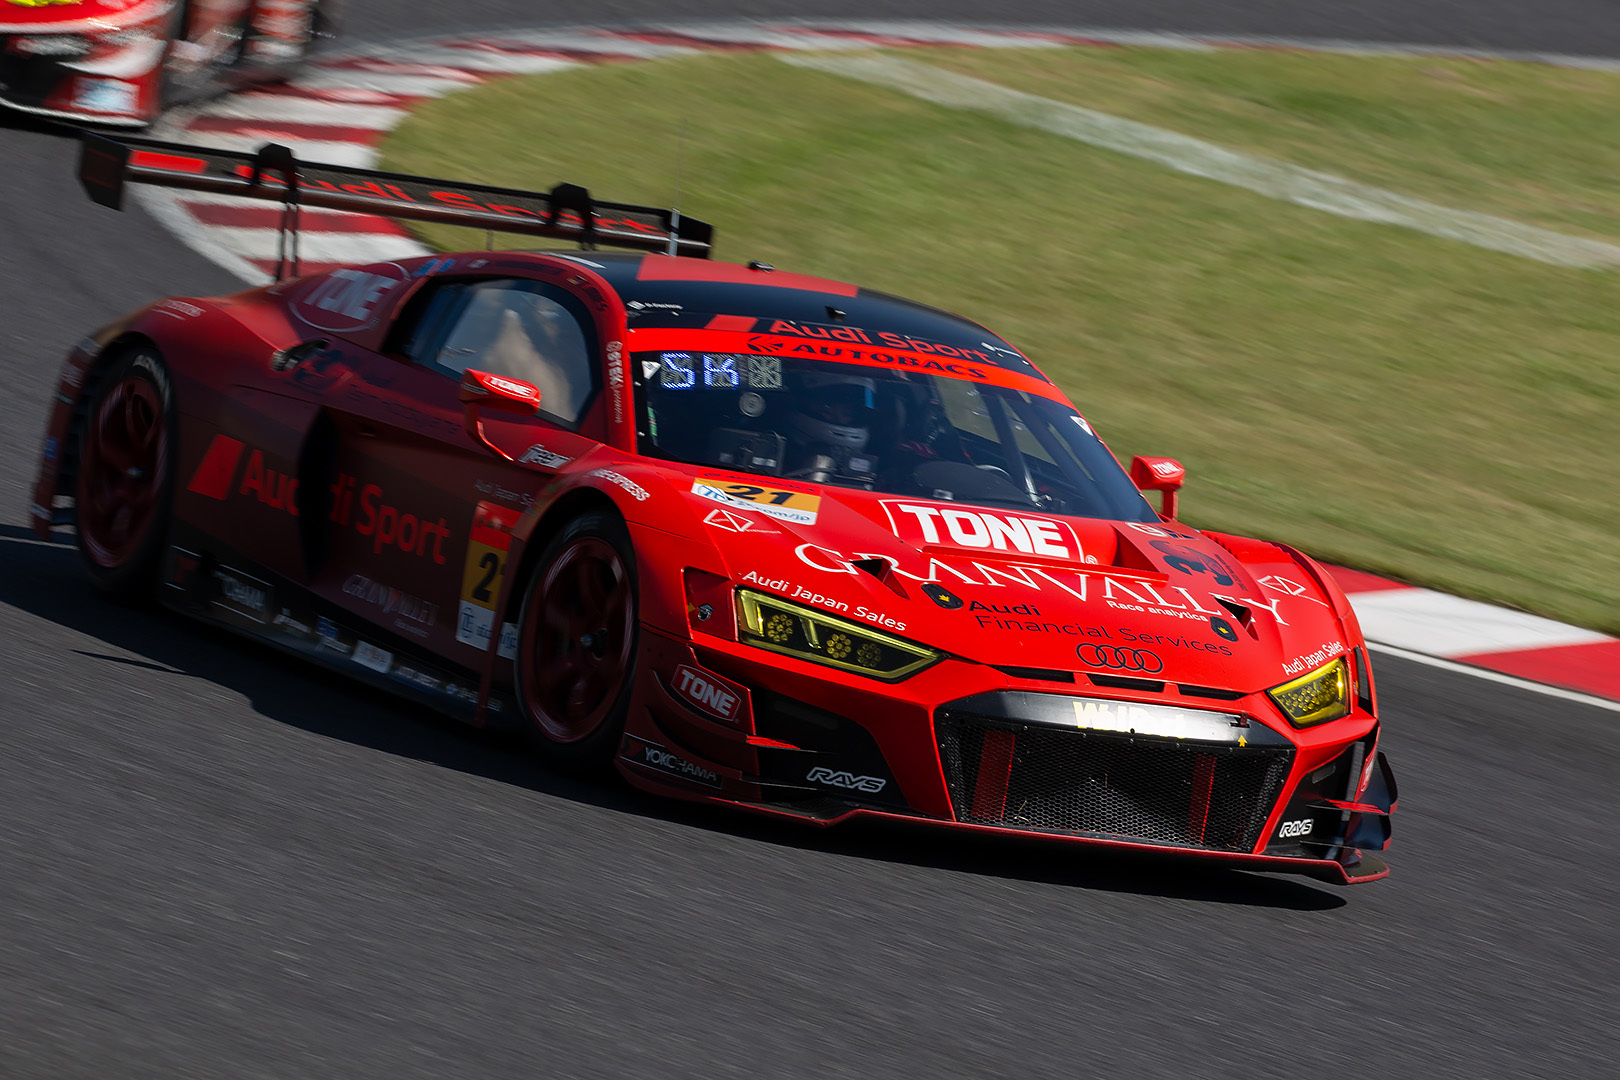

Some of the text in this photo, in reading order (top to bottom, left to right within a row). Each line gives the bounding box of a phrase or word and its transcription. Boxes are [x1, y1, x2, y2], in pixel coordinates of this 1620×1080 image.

[769, 319, 1000, 366] Audi Sport
[793, 344, 989, 379] AUTOBACS
[724, 485, 795, 505] 21
[355, 483, 451, 566] Sport
[898, 504, 1070, 559] TONE
[469, 552, 506, 604] 2
[742, 571, 907, 632] Audi Japan Sales
[968, 600, 1042, 617] Audi
[1106, 600, 1209, 623] Race analytics
[976, 614, 1234, 657] Financial Services
[1281, 641, 1344, 676] Audi Japan Sales
[681, 670, 735, 717] TONE
[645, 747, 718, 782] YOKOHAMA
[806, 767, 886, 793] RAYS
[1279, 818, 1314, 838] RAYS
